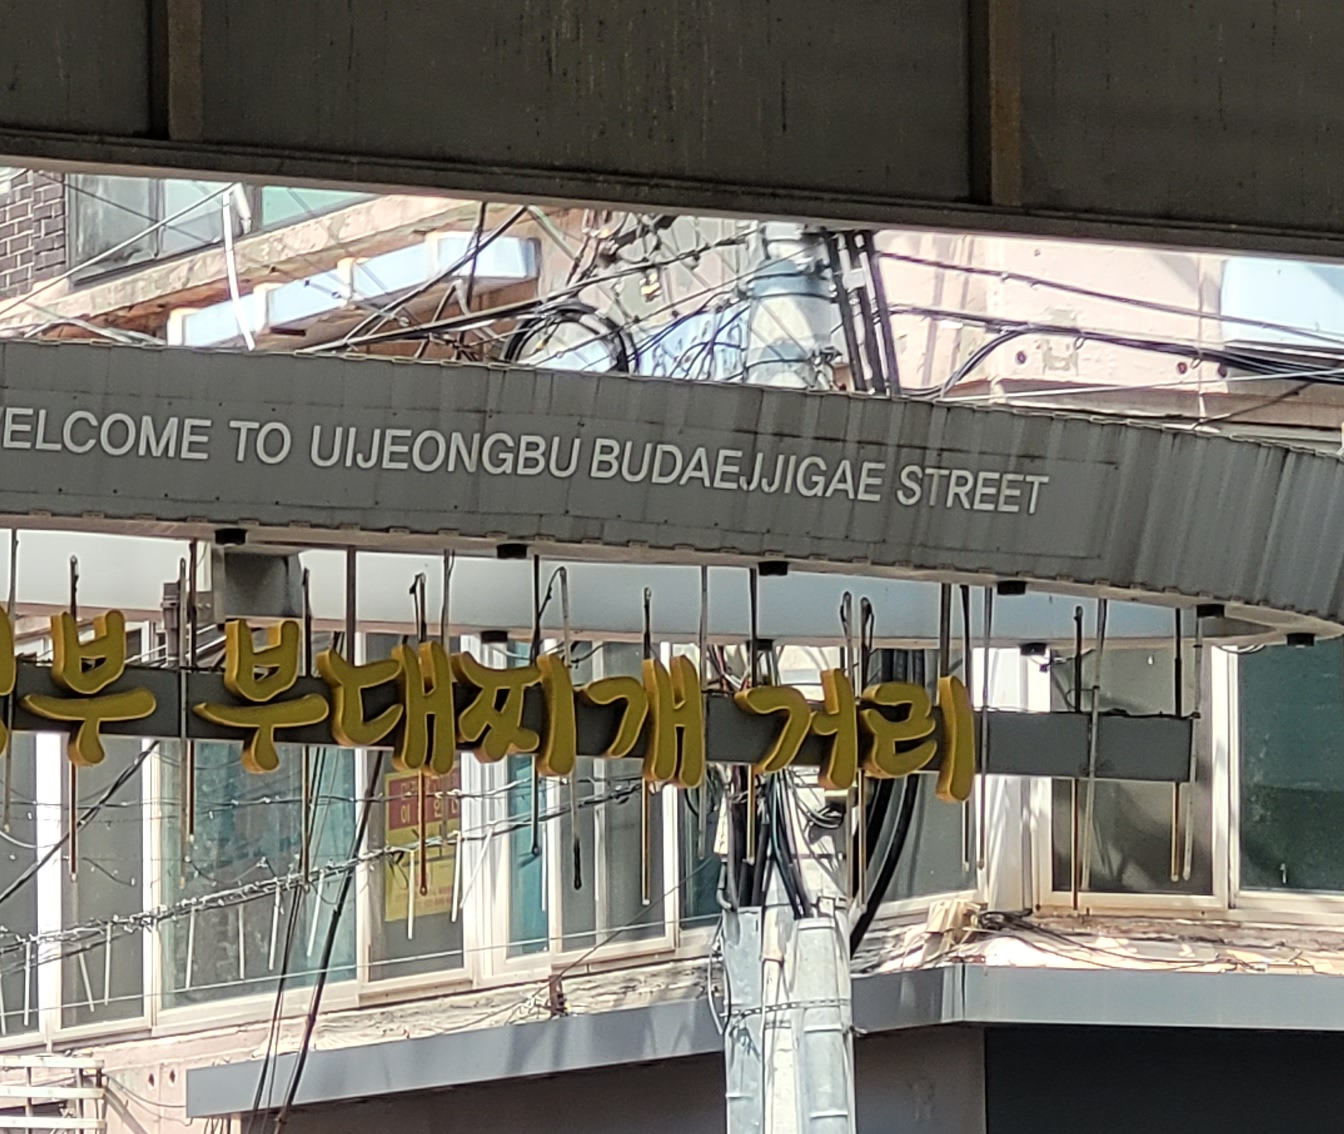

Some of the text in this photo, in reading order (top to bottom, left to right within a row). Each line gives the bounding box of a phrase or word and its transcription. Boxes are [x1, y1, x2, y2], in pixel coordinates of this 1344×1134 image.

[227, 420, 293, 467] TO
[308, 424, 581, 478] UIJEONGBU
[589, 439, 884, 503] BUDAEJJIGAE
[895, 462, 1049, 515] STREET
[193, 617, 705, 790] 부대찌개
[734, 668, 976, 802] 거리
